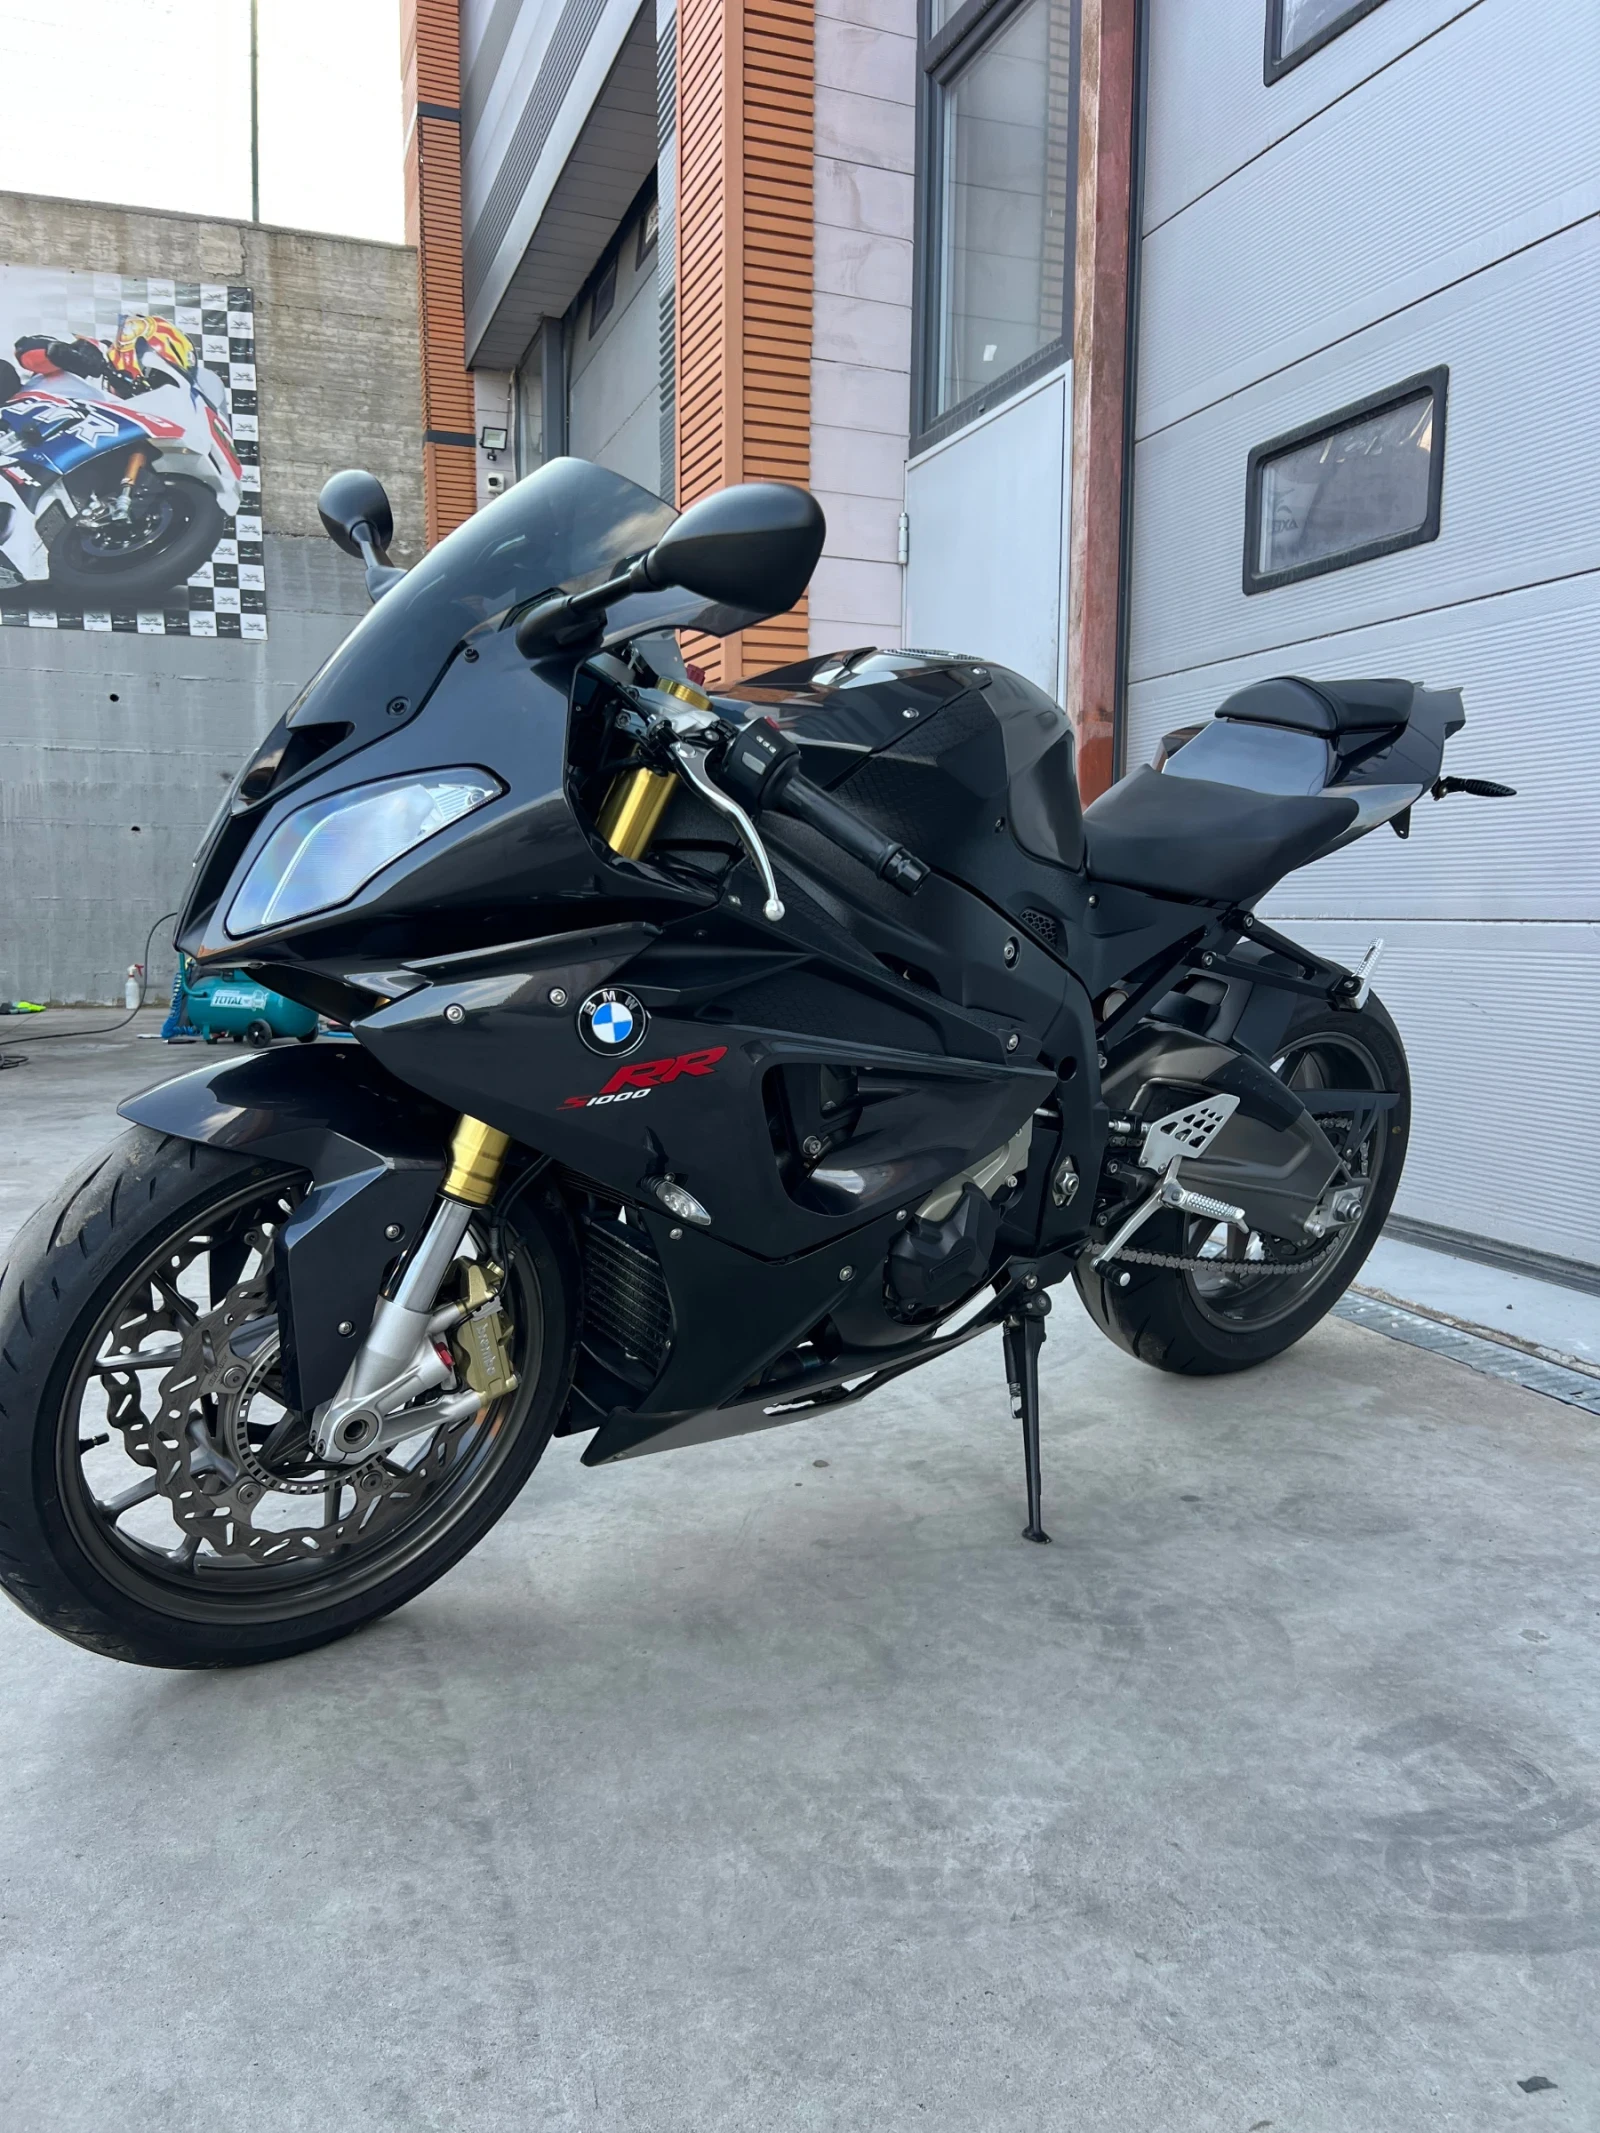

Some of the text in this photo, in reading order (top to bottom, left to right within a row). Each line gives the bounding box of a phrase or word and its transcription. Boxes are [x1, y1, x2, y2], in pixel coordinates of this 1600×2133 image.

[214, 995, 243, 1005] TOTAL
[583, 990, 640, 1016] BMW
[599, 1045, 729, 1094] RR
[555, 1088, 651, 1111] S1000
[476, 1323, 496, 1377] brembo
